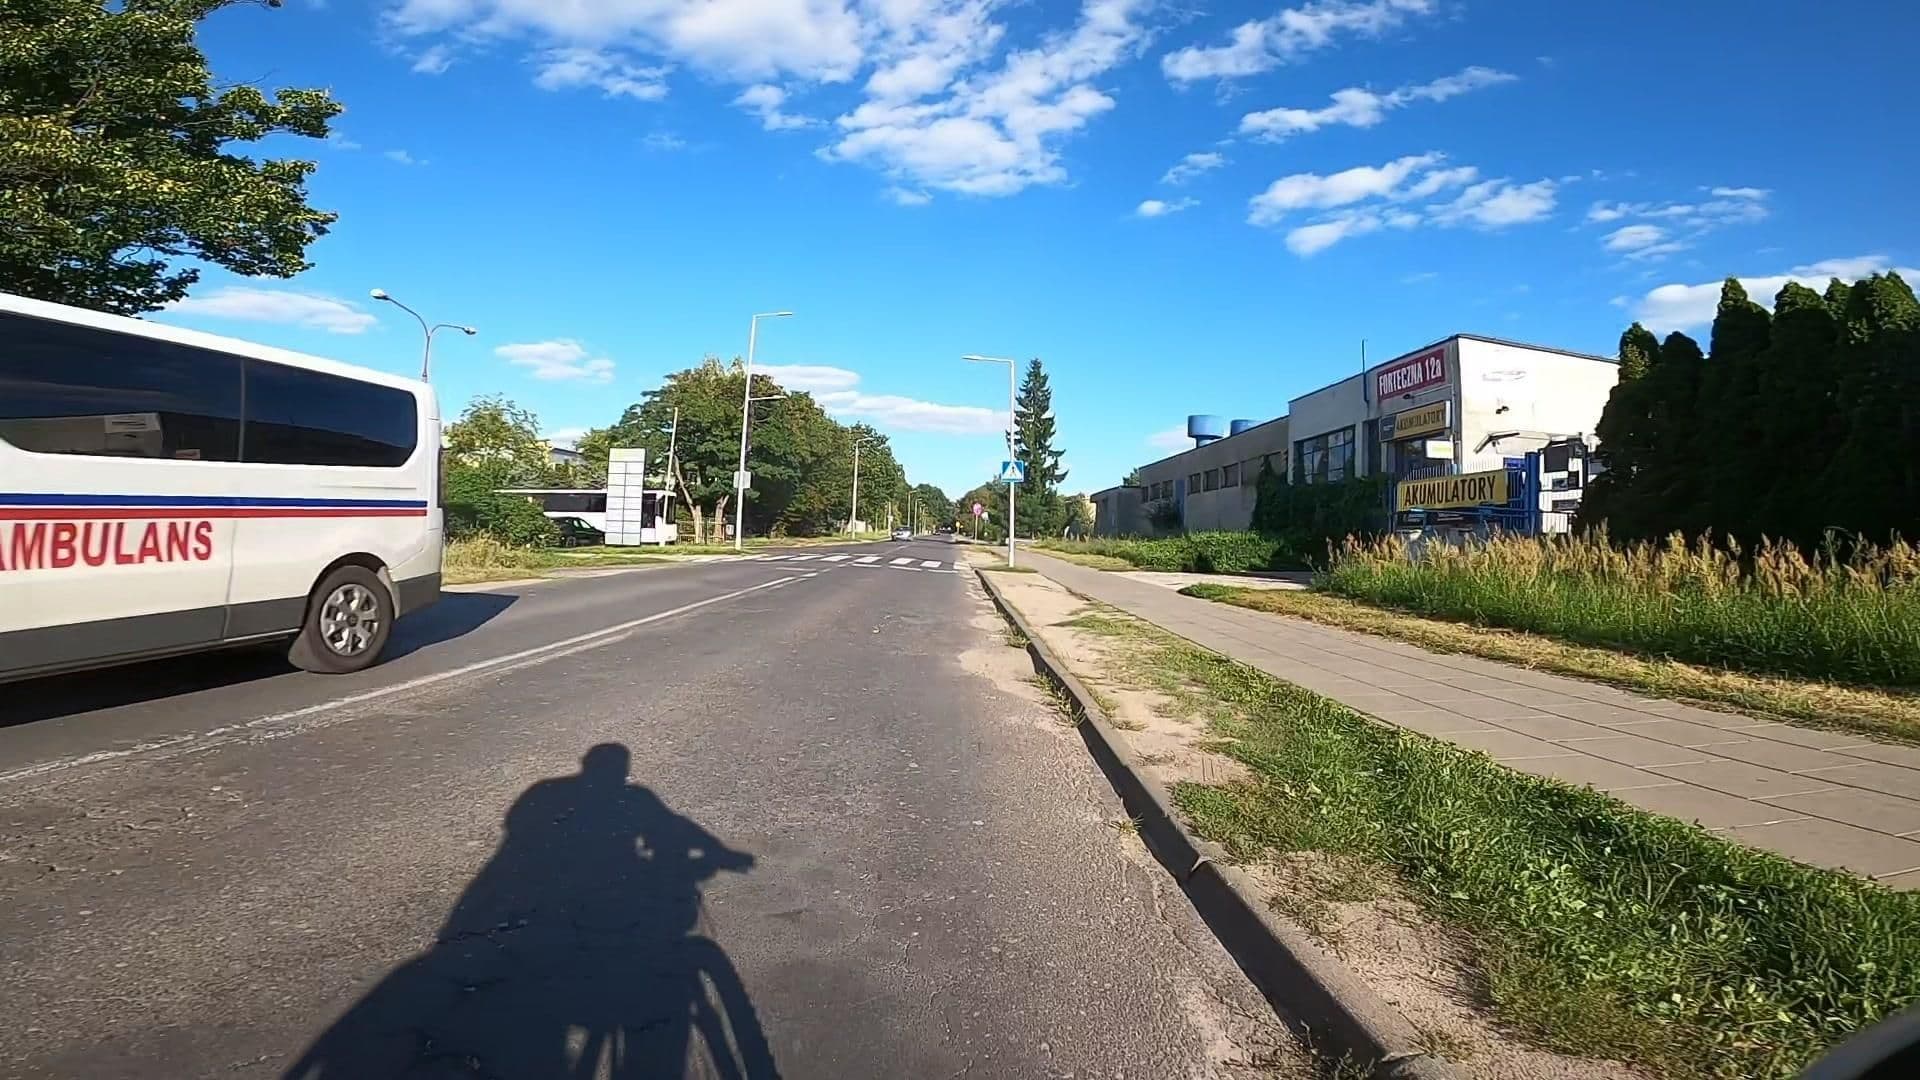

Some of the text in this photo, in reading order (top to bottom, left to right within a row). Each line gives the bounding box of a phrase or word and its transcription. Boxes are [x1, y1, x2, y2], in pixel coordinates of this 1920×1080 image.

[1378, 357, 1442, 395] FORTECZNA 12a
[1396, 408, 1444, 431] AKUMULATORY
[1404, 476, 1496, 506] AKUMULATORY
